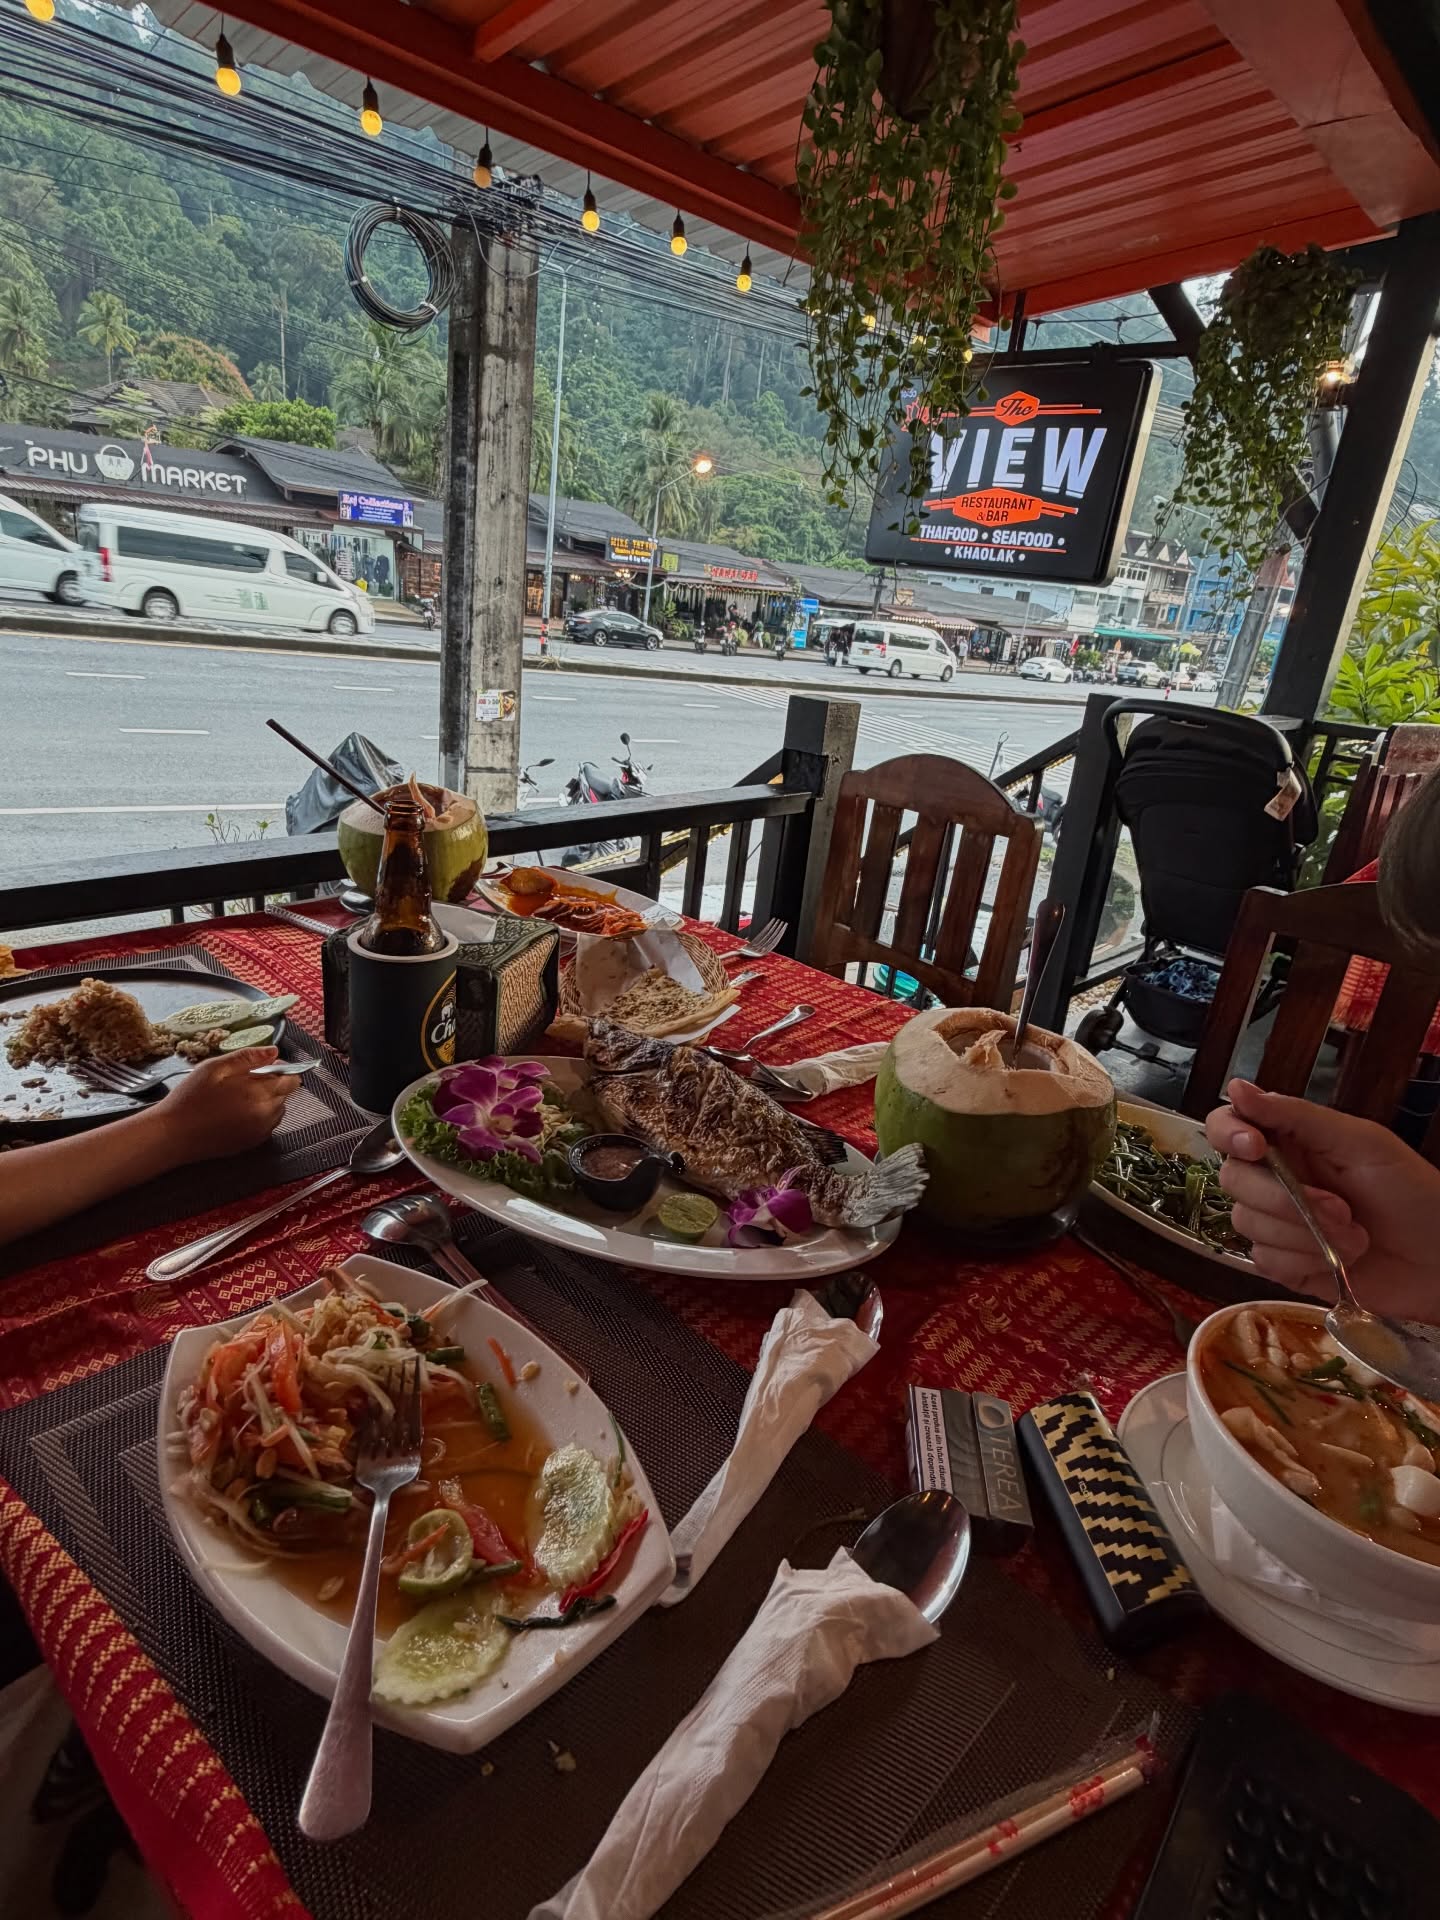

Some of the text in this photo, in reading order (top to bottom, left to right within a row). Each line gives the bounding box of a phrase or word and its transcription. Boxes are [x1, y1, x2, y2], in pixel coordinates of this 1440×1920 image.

[1000, 398, 1035, 418] The
[27, 447, 88, 474] PHU
[929, 427, 1108, 499] VIEW
[960, 496, 1036, 511] RESTAURANT
[986, 510, 1009, 522] BAR
[919, 525, 1054, 549] THAIFOOD SEAFOOD
[954, 547, 1015, 564] KHAOLAK
[932, 1408, 941, 1433] produs
[989, 1436, 1023, 1510] TEREA
